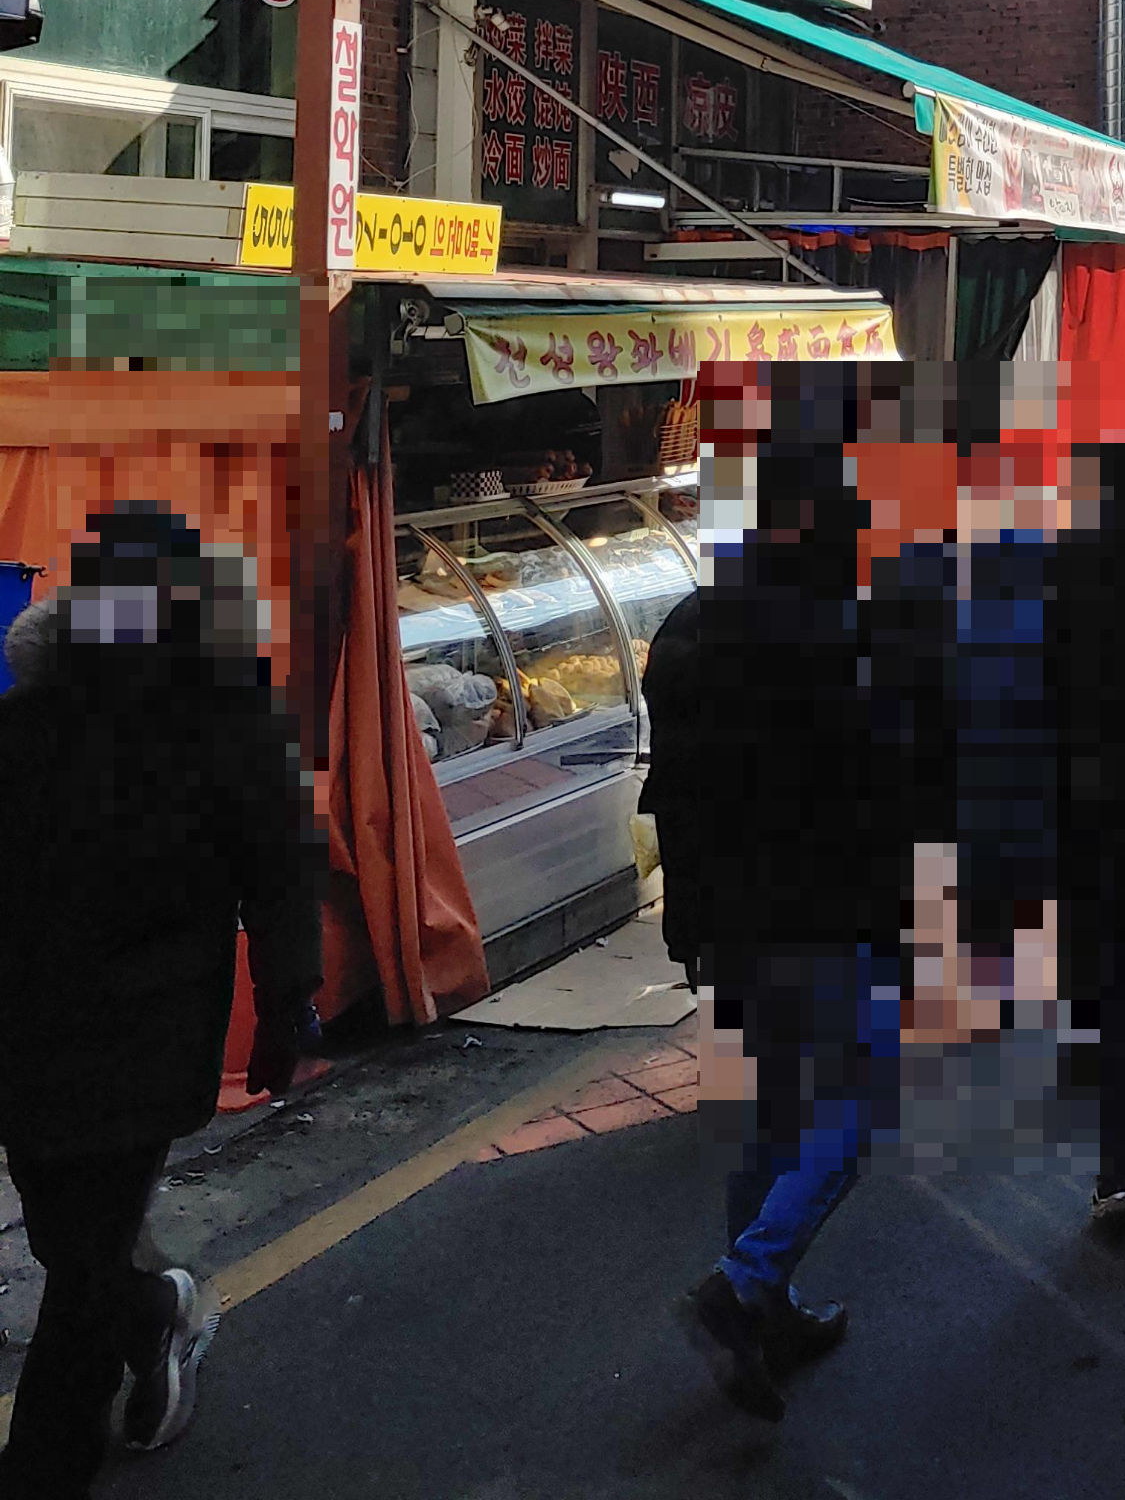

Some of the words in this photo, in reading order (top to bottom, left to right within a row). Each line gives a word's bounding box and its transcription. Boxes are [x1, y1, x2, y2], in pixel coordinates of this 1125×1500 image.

[483, 68, 526, 126] 水饺
[596, 50, 661, 127] 陕西
[482, 131, 525, 185] 冷面
[532, 135, 572, 190] 炒面
[948, 155, 974, 194] 특별한
